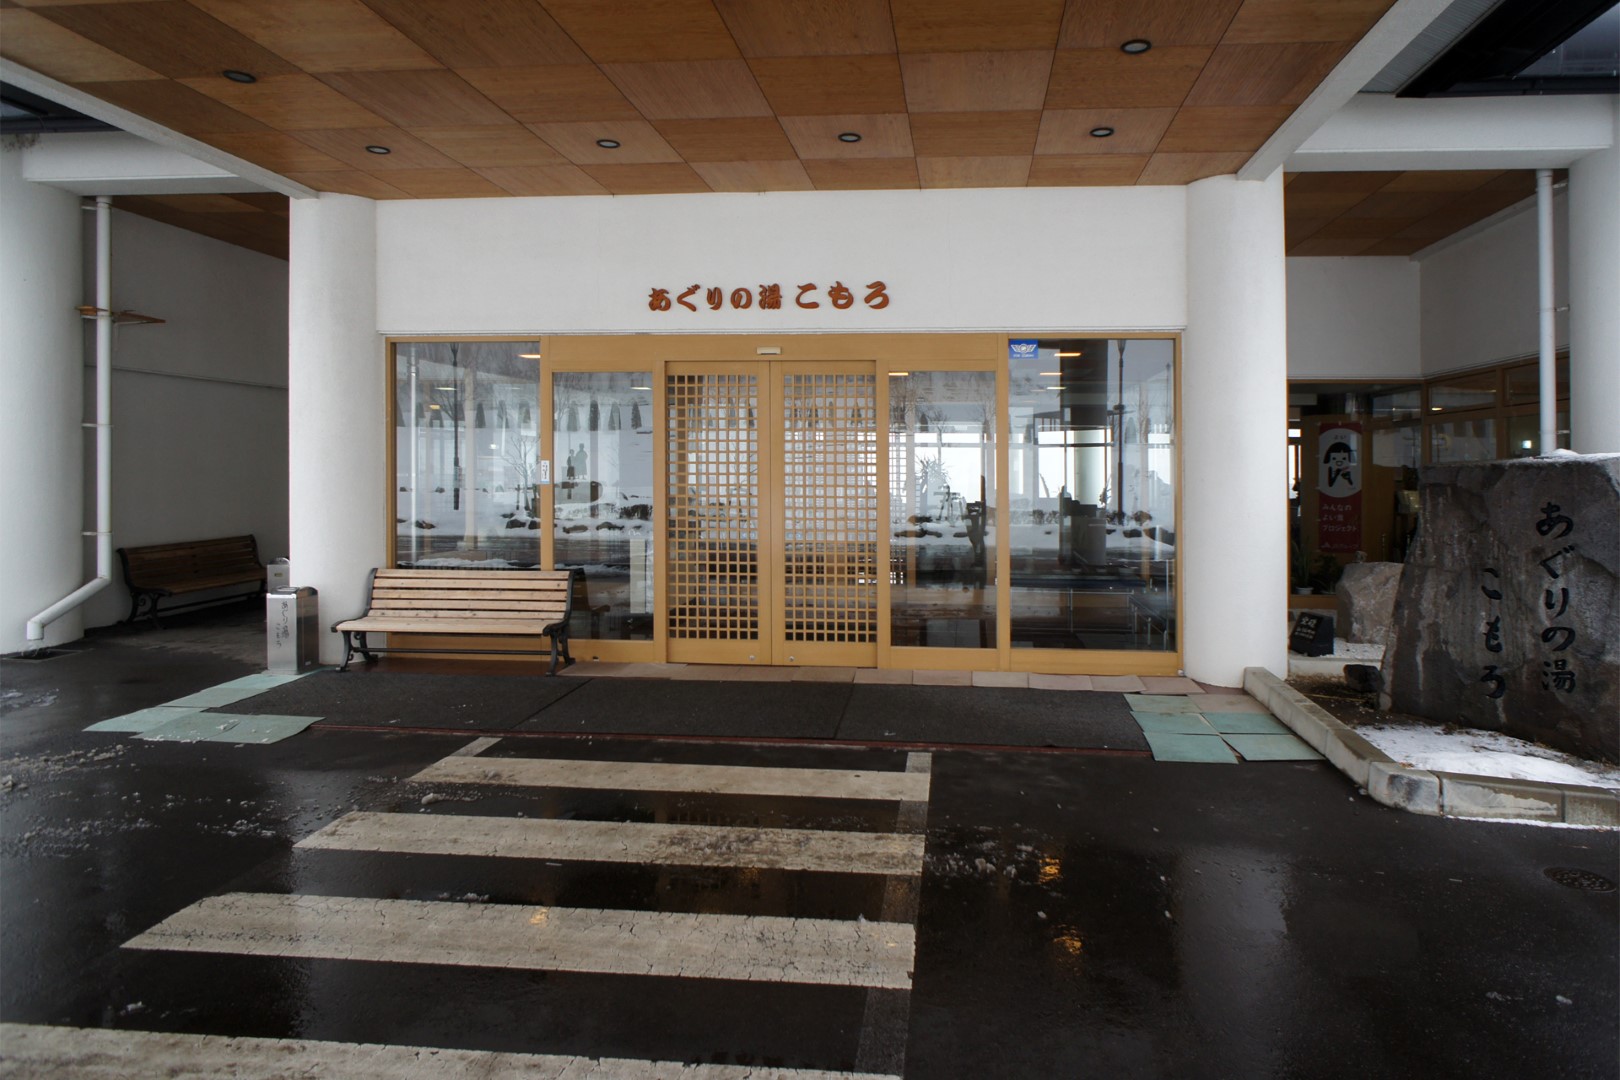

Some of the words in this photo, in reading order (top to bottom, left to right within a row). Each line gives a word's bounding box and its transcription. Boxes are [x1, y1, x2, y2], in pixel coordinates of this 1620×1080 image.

[1322, 503, 1352, 511] みんなの
[1480, 567, 1506, 699] こもろ
[1535, 501, 1577, 694] あぐりの湯
